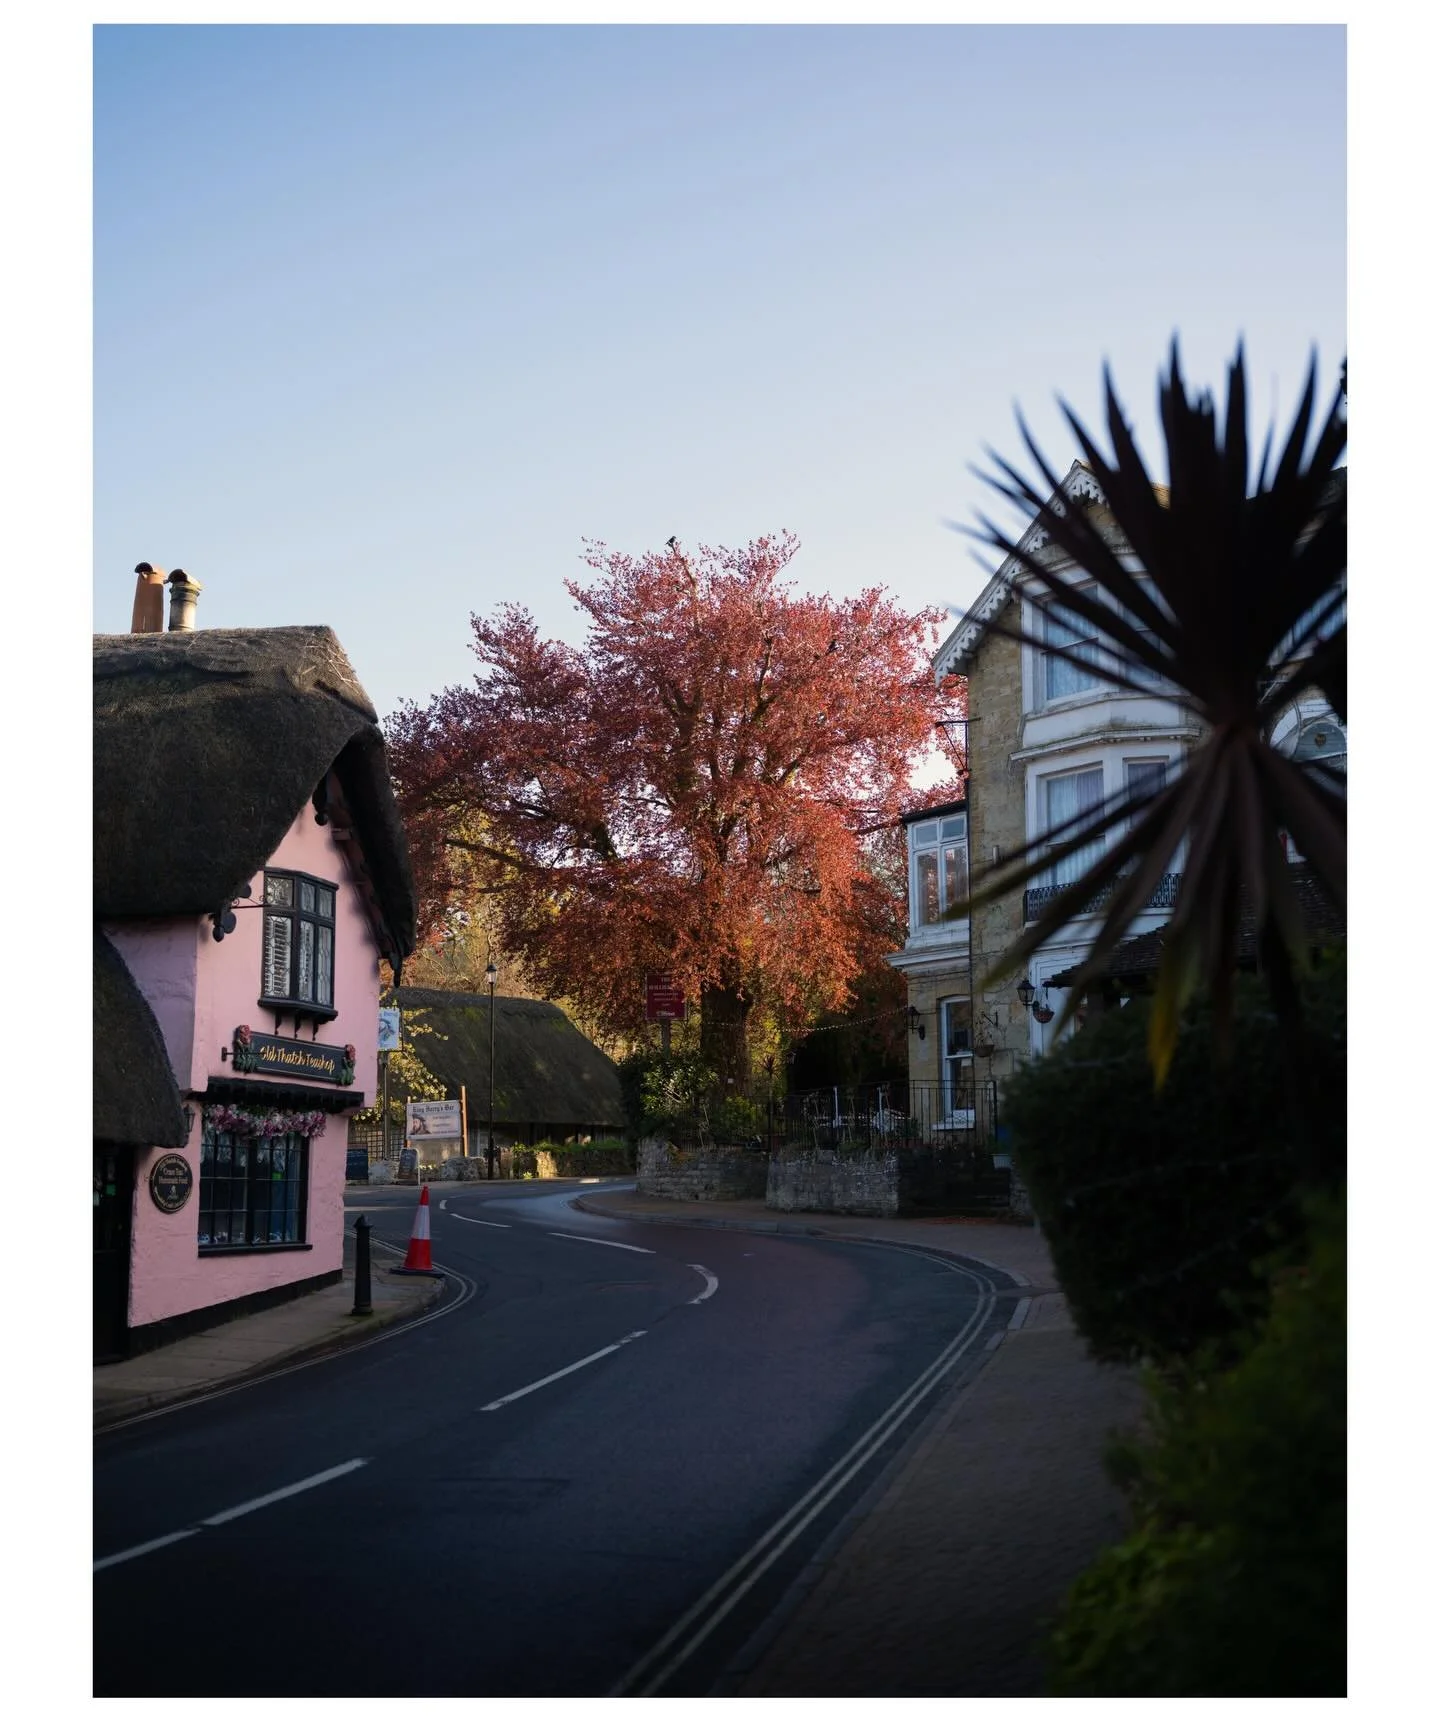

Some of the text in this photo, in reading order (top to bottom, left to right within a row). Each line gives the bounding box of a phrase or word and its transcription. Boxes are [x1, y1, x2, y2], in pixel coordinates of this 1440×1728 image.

[260, 1045, 335, 1075] Old Thatch Teashop
